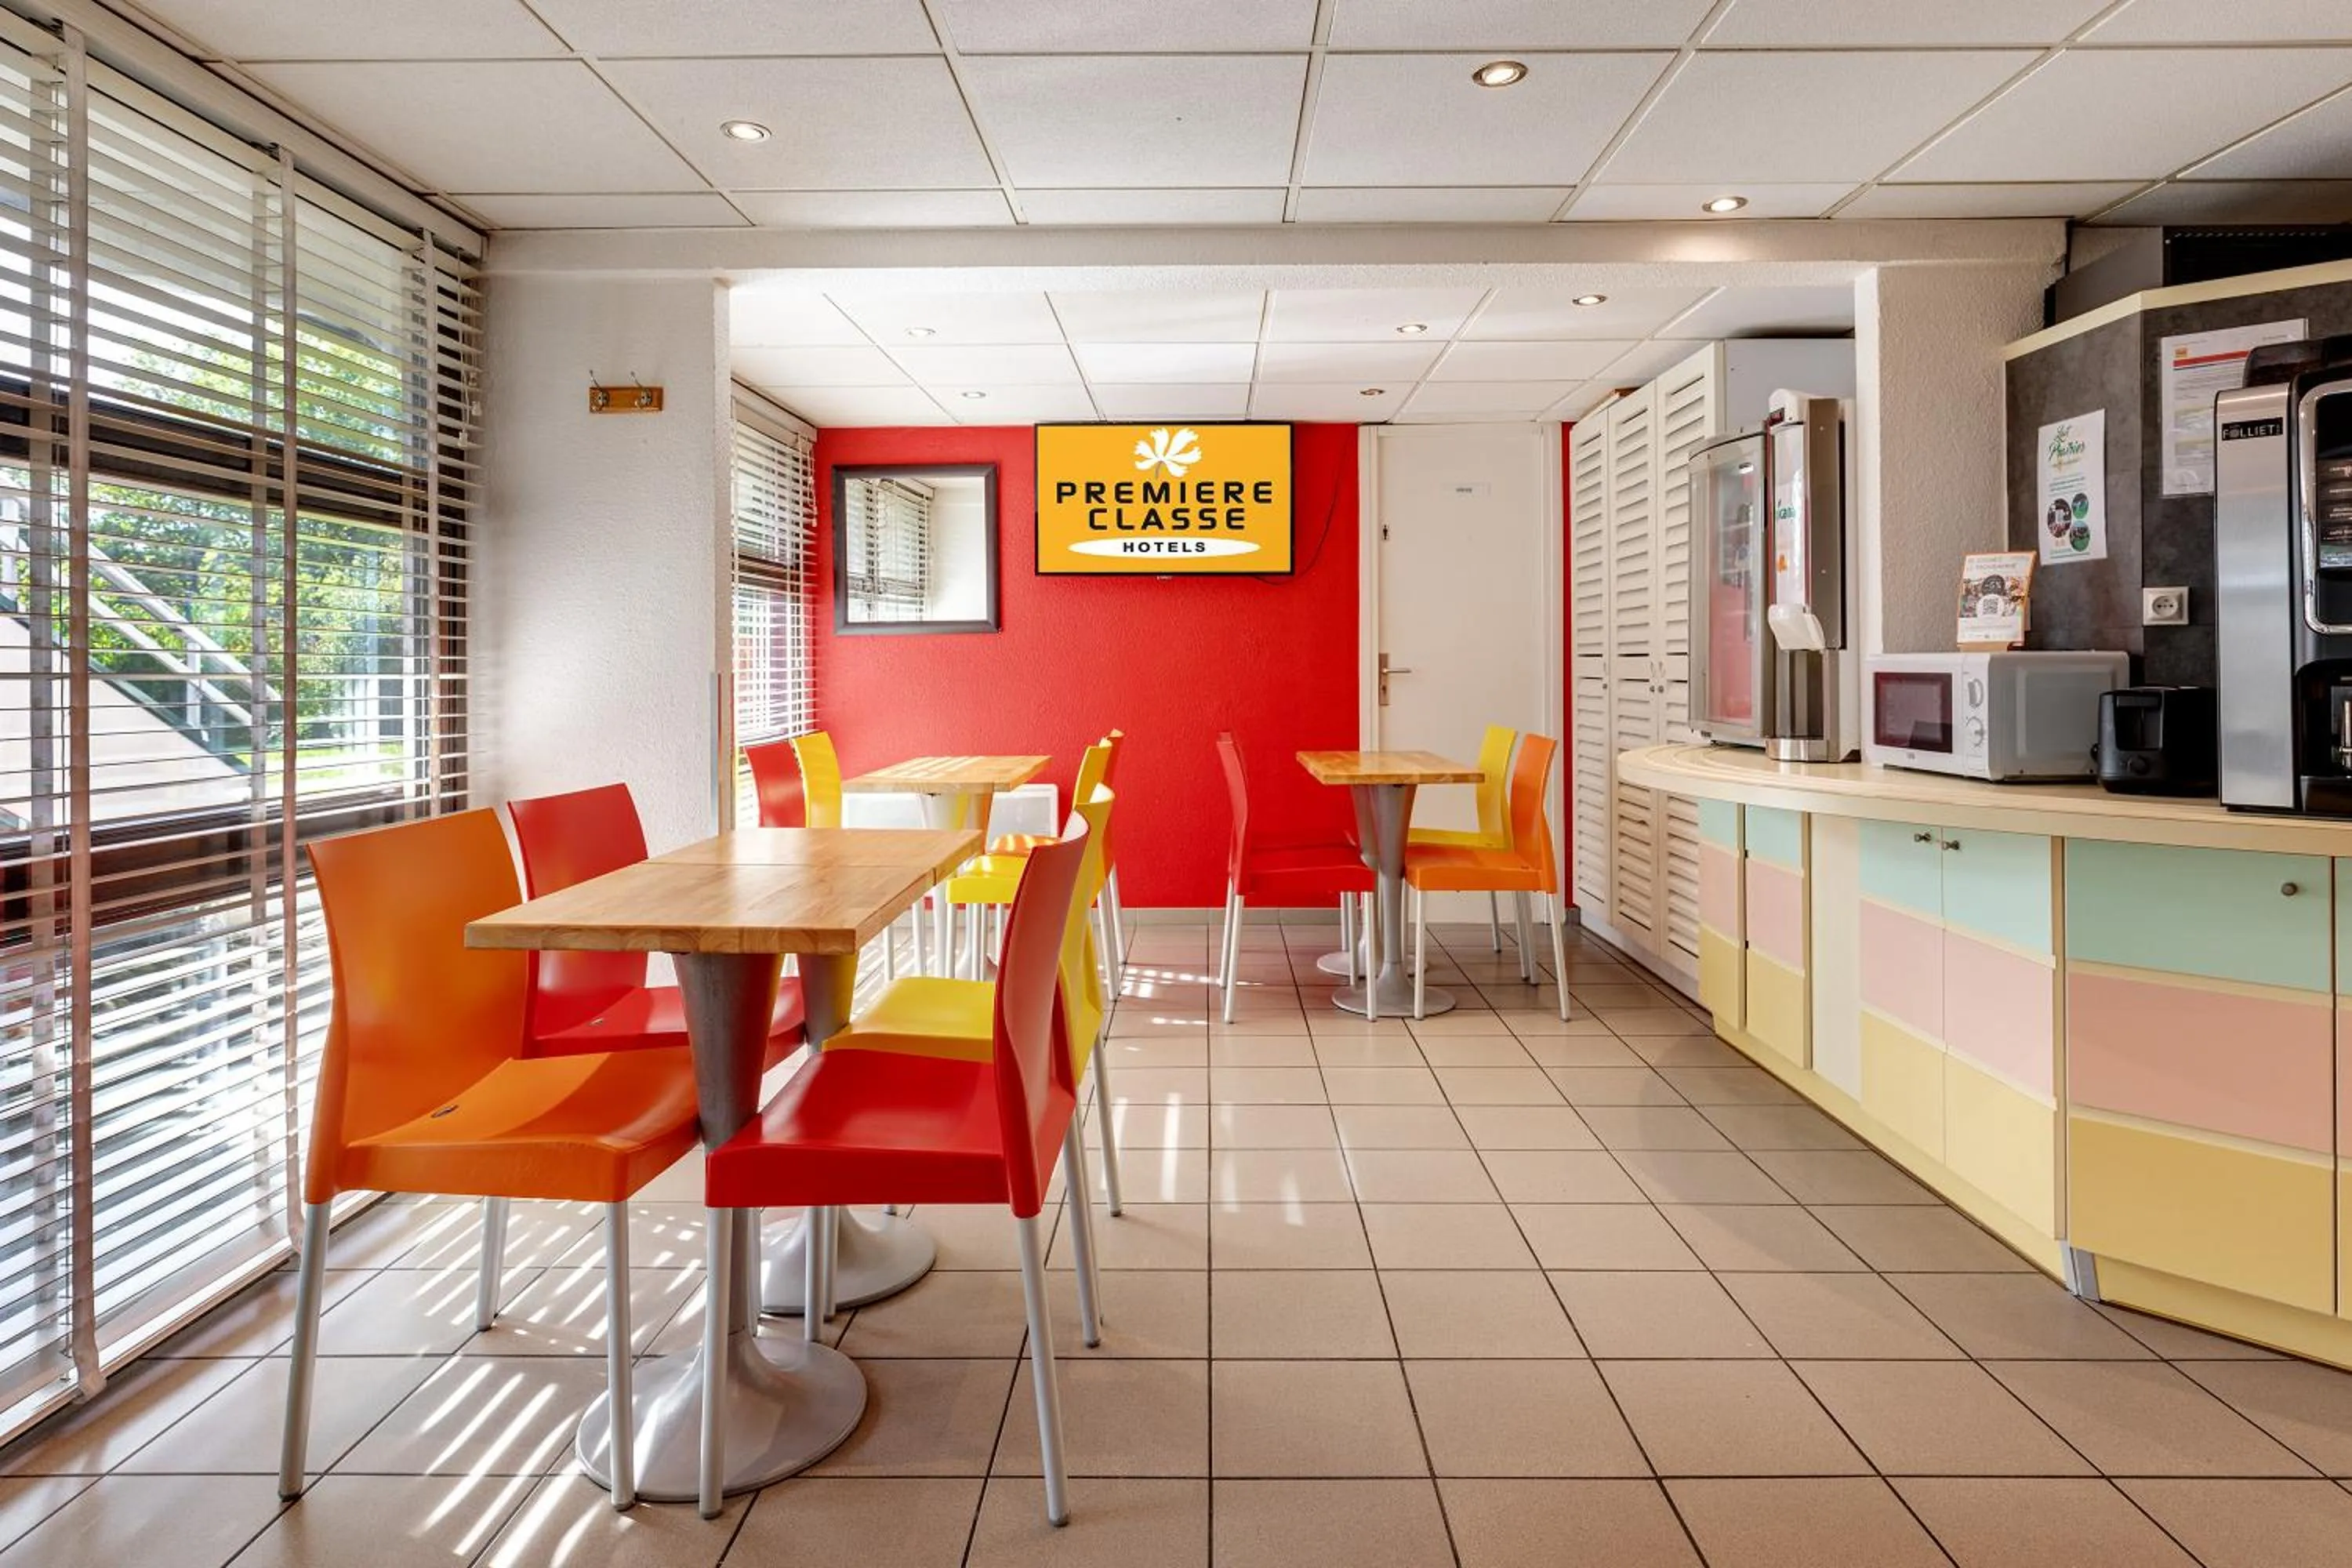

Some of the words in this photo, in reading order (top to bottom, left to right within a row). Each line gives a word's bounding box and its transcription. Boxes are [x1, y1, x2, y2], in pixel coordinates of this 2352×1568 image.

[2223, 424, 2275, 440] FOLLIET
[1056, 481, 1272, 503] PREMIERE
[1089, 508, 1245, 530] CLASSE
[1123, 542, 1206, 553] HOTELS
